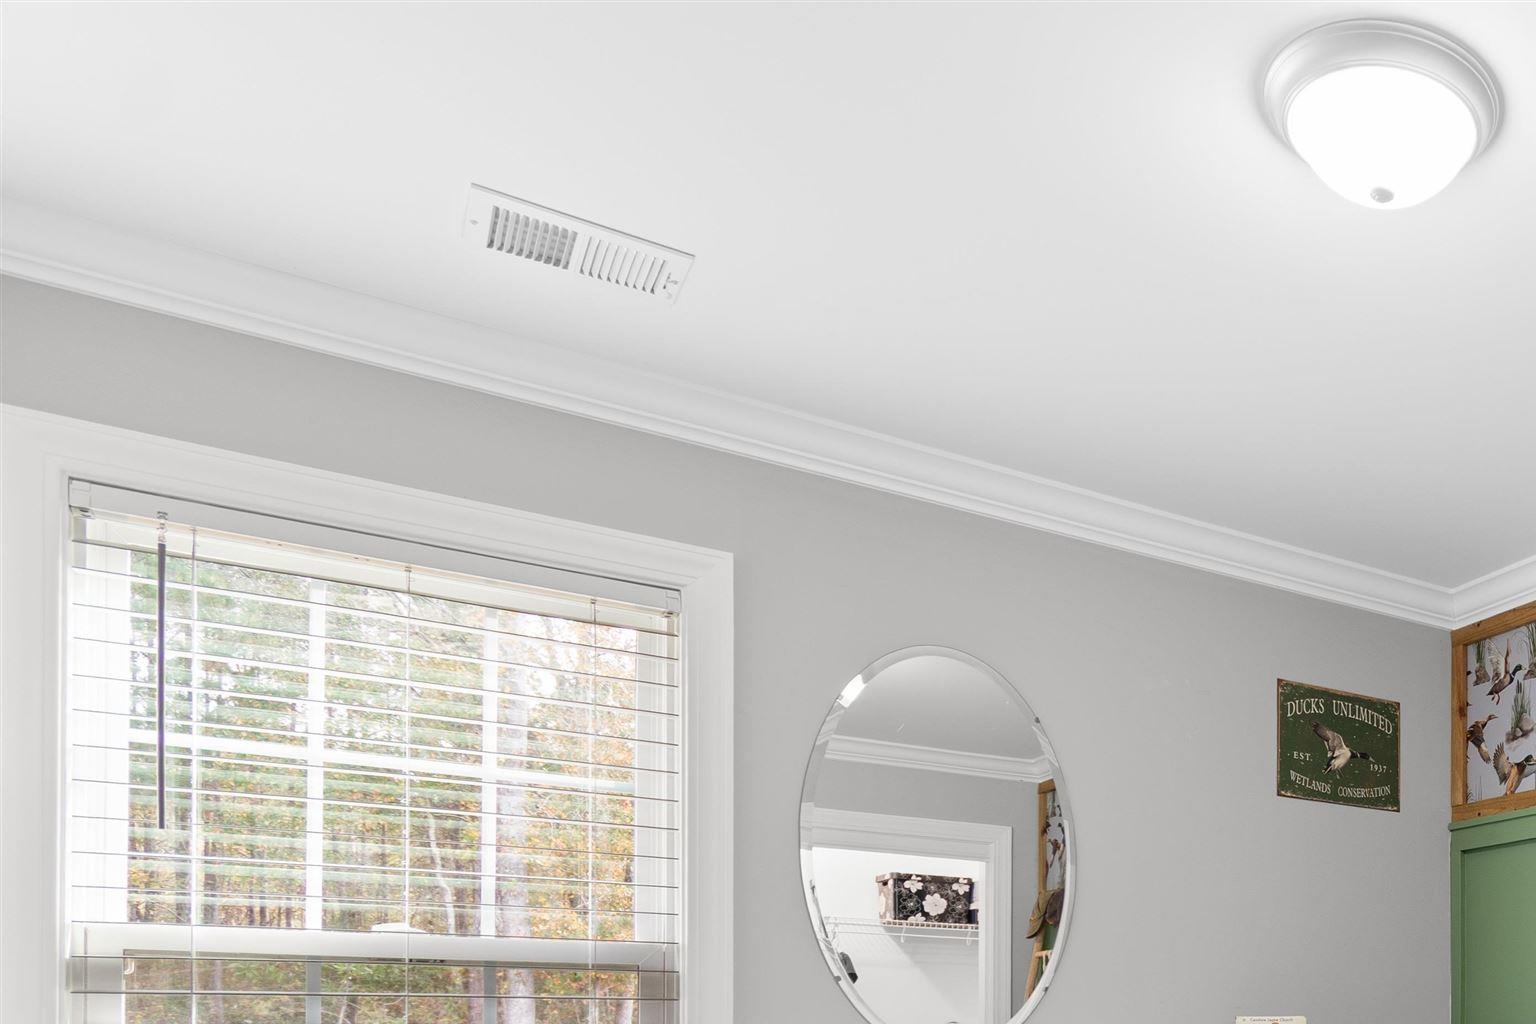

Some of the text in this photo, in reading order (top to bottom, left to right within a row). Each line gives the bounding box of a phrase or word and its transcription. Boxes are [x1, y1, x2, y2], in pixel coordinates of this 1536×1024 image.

[1287, 698, 1393, 735] DUCKS UNLIMITED
[1293, 751, 1387, 773] EST. 1937
[1289, 769, 1391, 798] WETLANDS CONSERVATION
